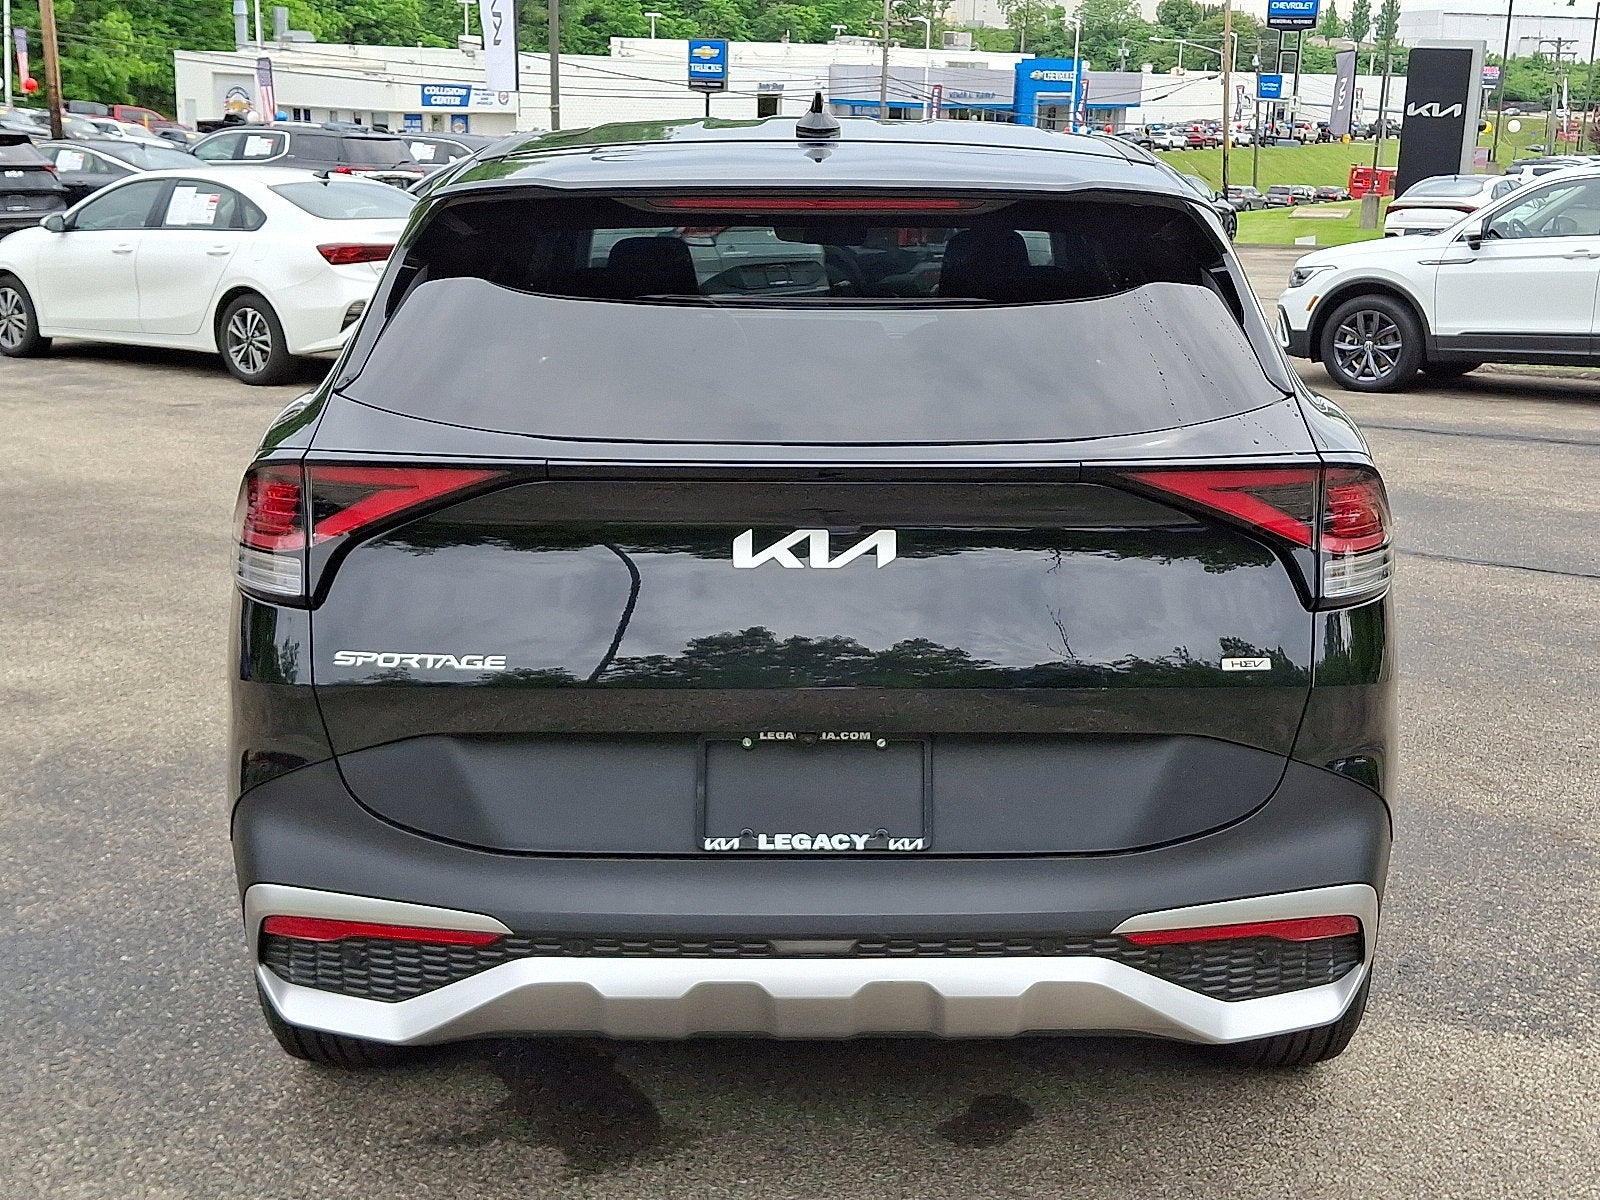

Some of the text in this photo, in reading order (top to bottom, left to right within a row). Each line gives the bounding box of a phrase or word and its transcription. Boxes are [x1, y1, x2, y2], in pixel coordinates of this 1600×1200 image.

[1271, 1, 1314, 10] CHEVROLET
[689, 63, 723, 73] TRUCKS
[424, 86, 467, 95] COLLISION
[430, 96, 461, 105] CENTER
[1406, 101, 1463, 118] KIA
[732, 529, 897, 569] KIA
[333, 650, 507, 670] SPORTAGE
[1231, 660, 1264, 668] HEV
[704, 833, 923, 850] KIA LEGACY KIA
